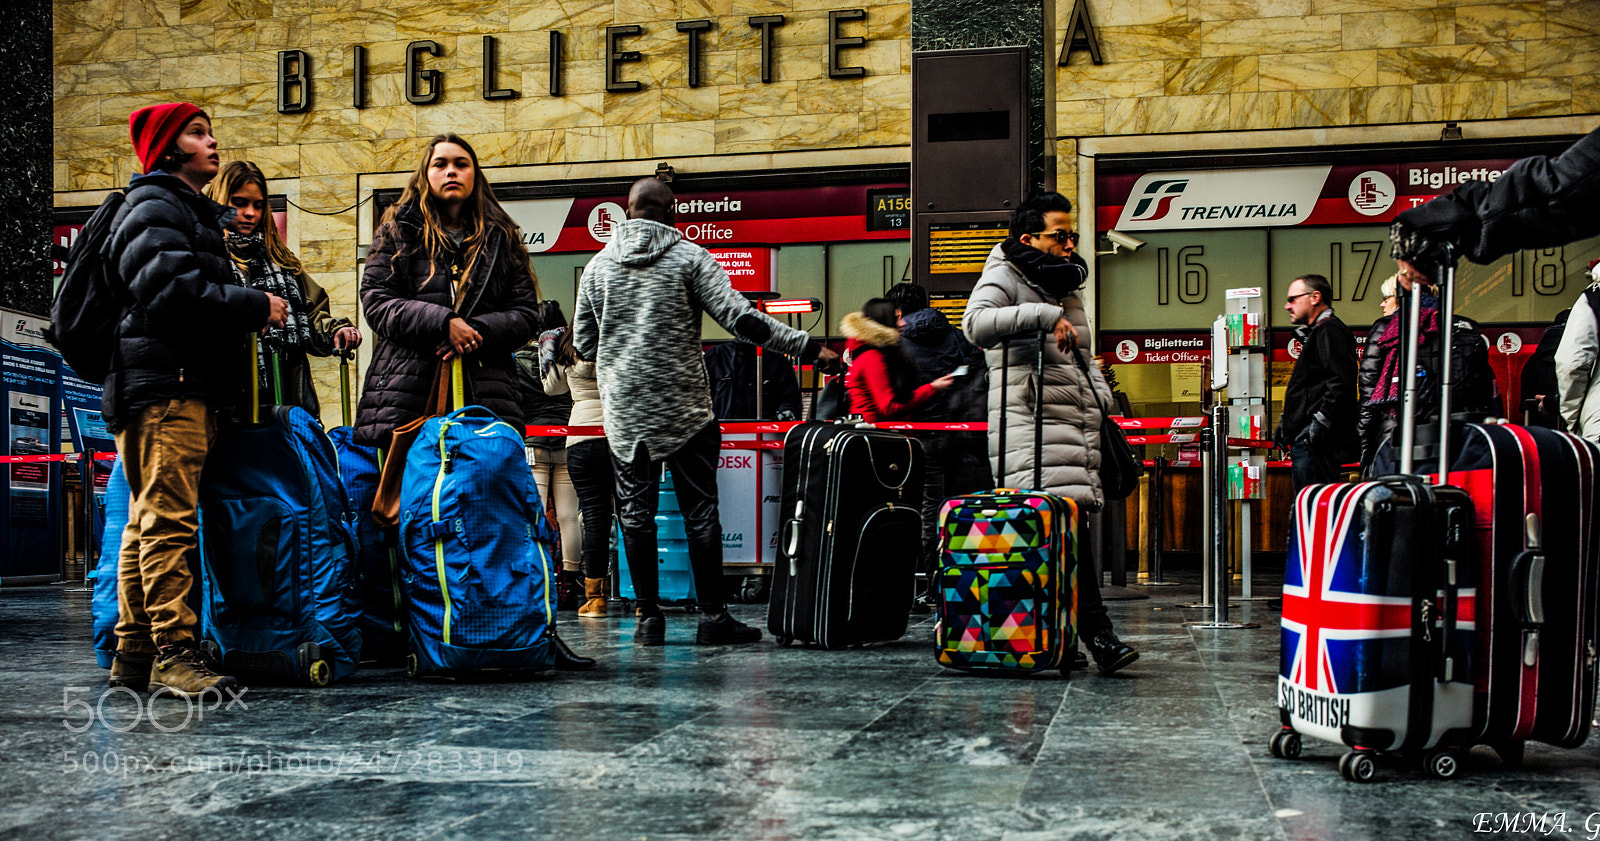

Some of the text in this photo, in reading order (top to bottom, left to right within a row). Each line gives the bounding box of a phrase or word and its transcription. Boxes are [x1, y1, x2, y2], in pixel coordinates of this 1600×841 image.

[1409, 166, 1507, 189] Bigliette
[674, 196, 741, 214] ietteria
[877, 198, 911, 211] A156
[1181, 203, 1297, 220] TRENITALIA
[890, 218, 902, 227] 13
[685, 223, 733, 240] Office
[1157, 245, 1208, 305] 16
[1331, 241, 1383, 301] 17
[1512, 246, 1565, 296] 18
[1144, 338, 1203, 349] Biglietteria
[1145, 352, 1199, 362] Ticket Office
[717, 456, 752, 469] DESK
[1281, 682, 1350, 729] SO BRITISH
